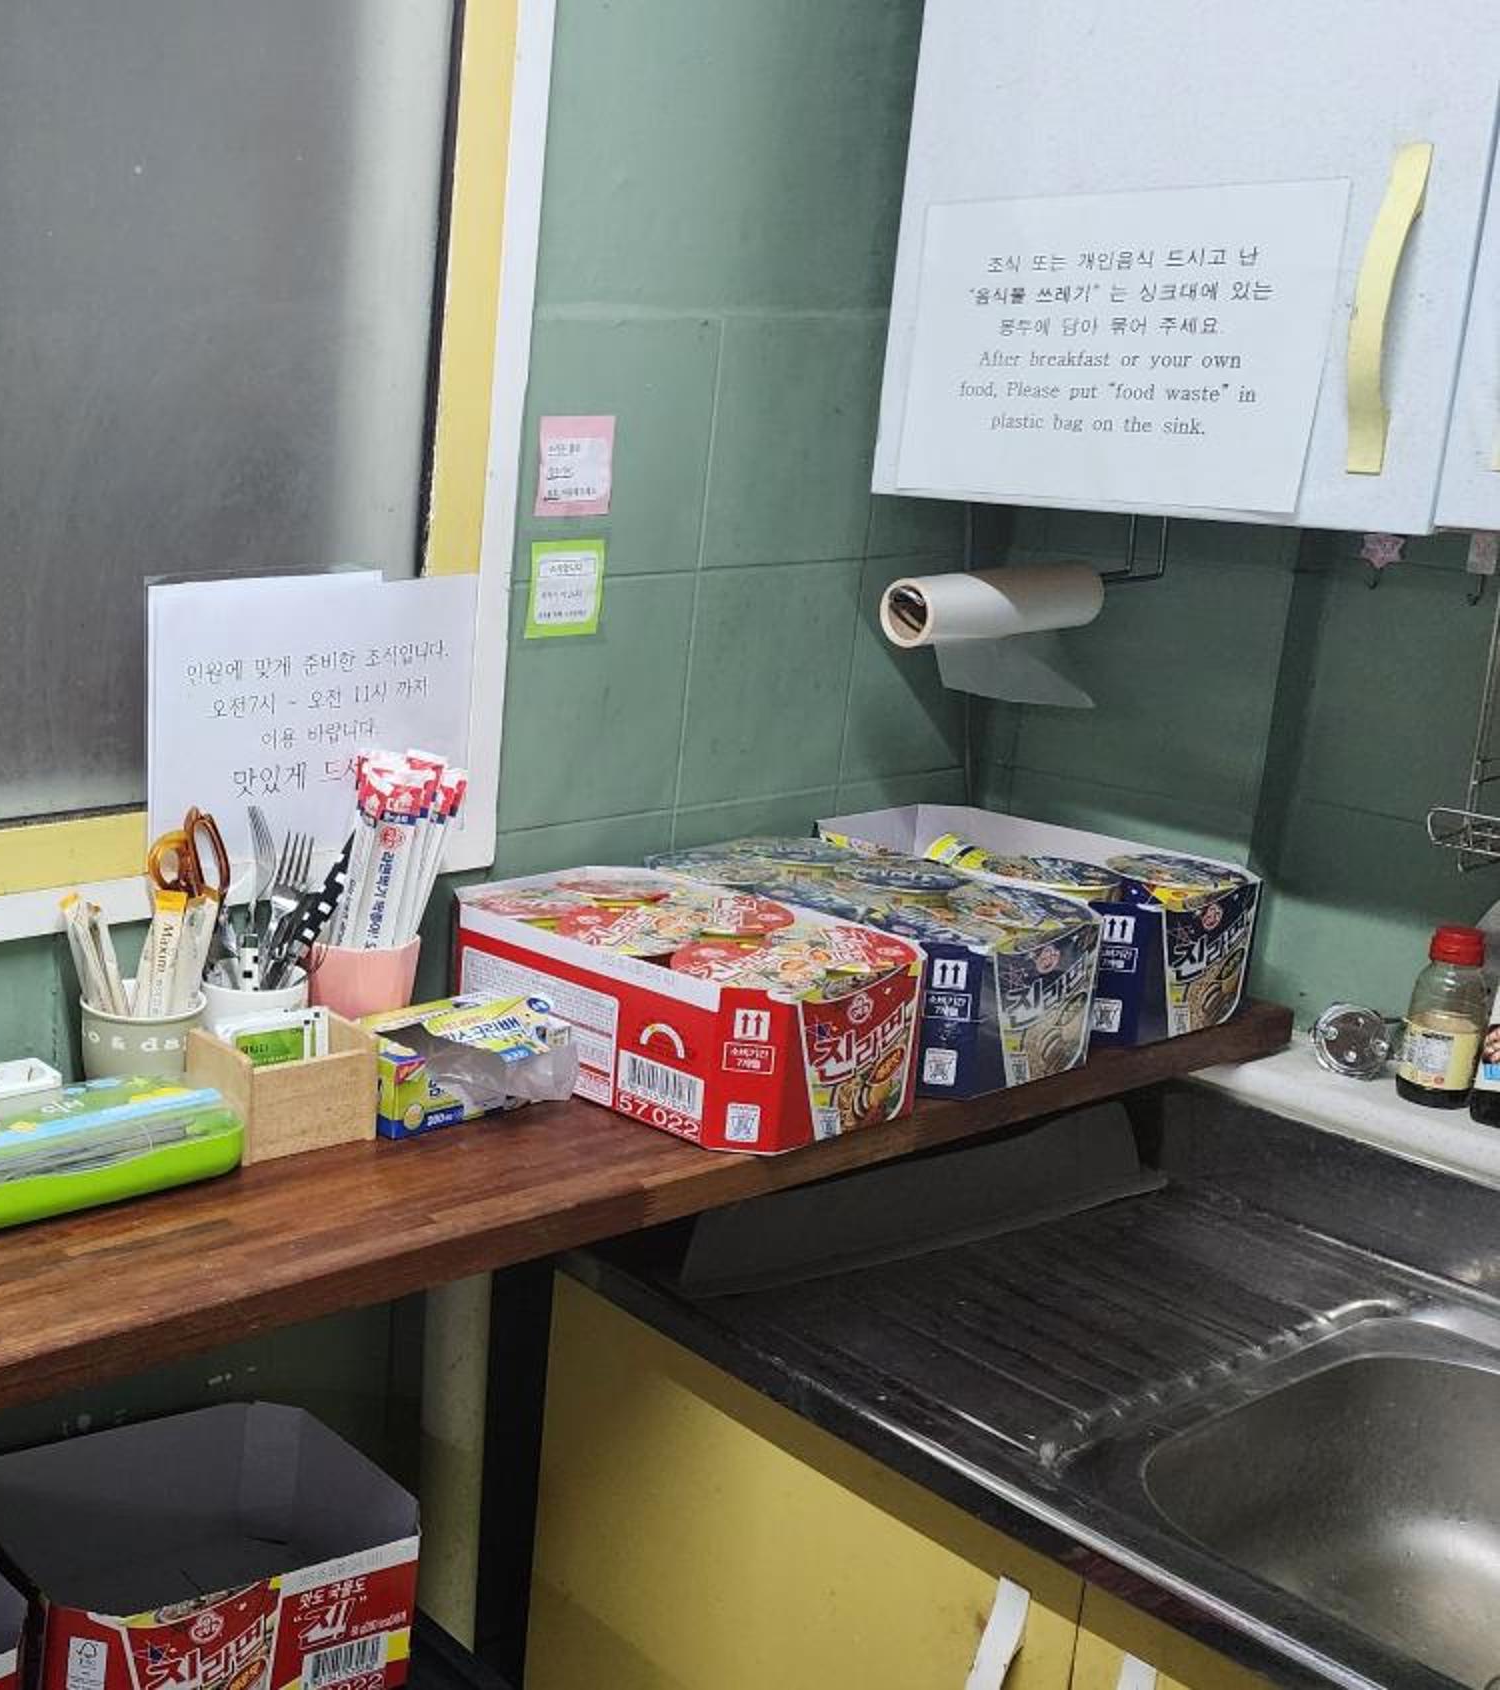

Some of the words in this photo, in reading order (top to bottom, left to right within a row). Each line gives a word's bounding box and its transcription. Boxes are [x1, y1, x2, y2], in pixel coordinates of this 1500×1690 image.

[987, 255, 1021, 273] 조식
[1032, 255, 1067, 272] 또는
[1078, 251, 1154, 271] 개인음식
[1166, 248, 1227, 267] 드시고
[1239, 246, 1259, 267] 난
[1110, 285, 1128, 303] 는
[1140, 282, 1219, 303] 싱크대에
[1231, 281, 1274, 301] 있는
[1062, 317, 1098, 337] 담아
[1110, 316, 1147, 336] 묶어
[979, 351, 1022, 367] After
[1029, 350, 1110, 367] breakfast
[1121, 354, 1140, 367] or
[1150, 355, 1192, 369] your
[1201, 355, 1241, 369] own
[1007, 381, 1060, 399] Please
[1069, 385, 1098, 400] put
[1238, 385, 1256, 403] in
[991, 413, 1044, 431] plastic
[1053, 413, 1083, 432] bag
[1092, 418, 1113, 432] on
[1124, 416, 1152, 432] the
[1164, 417, 1205, 435] sink.
[188, 659, 243, 686] 인원에
[255, 656, 291, 679] 맞게
[303, 650, 356, 676] 준비한
[308, 686, 341, 709] 오전
[355, 681, 388, 703] 11시
[397, 675, 427, 699] 까지
[261, 727, 297, 751] 이용
[233, 761, 307, 798] 맛있게
[157, 922, 174, 974] Maxim
[619, 1094, 699, 1135] 57022
